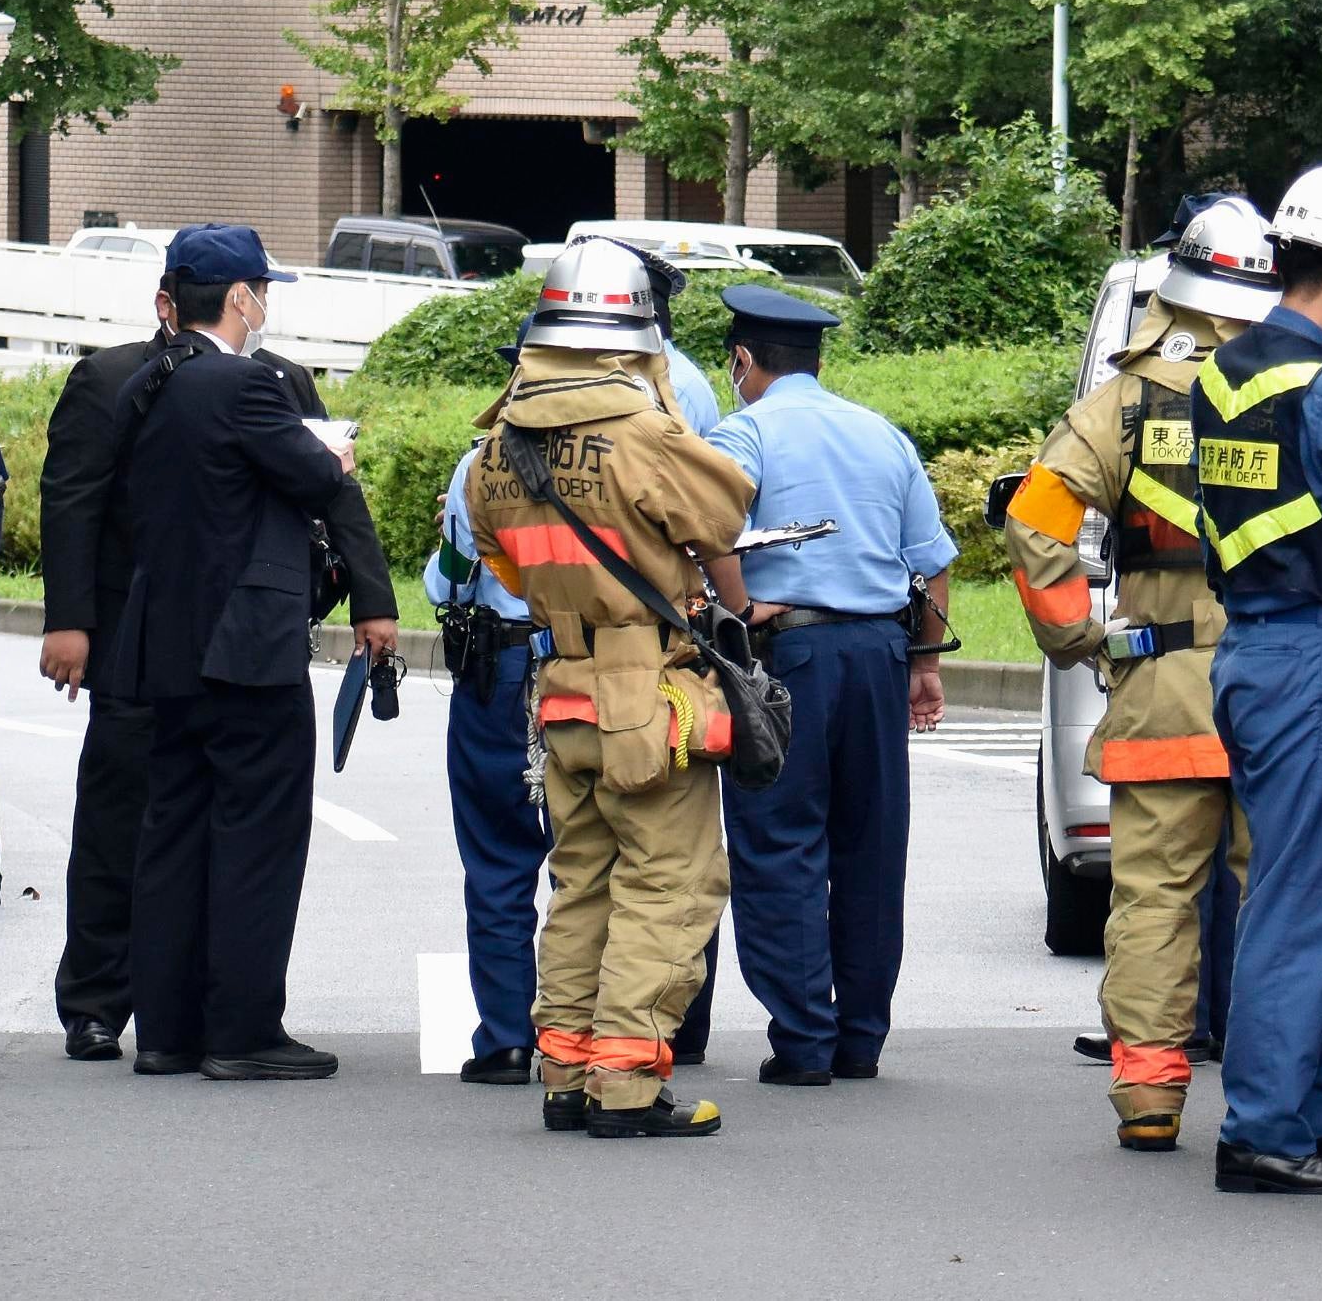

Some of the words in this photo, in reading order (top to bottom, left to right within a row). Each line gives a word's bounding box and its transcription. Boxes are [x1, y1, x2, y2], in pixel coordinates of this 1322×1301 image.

[1151, 447, 1192, 459] TOKYO
[1237, 471, 1268, 485] DEPT.
[558, 477, 610, 503] DEPT.
